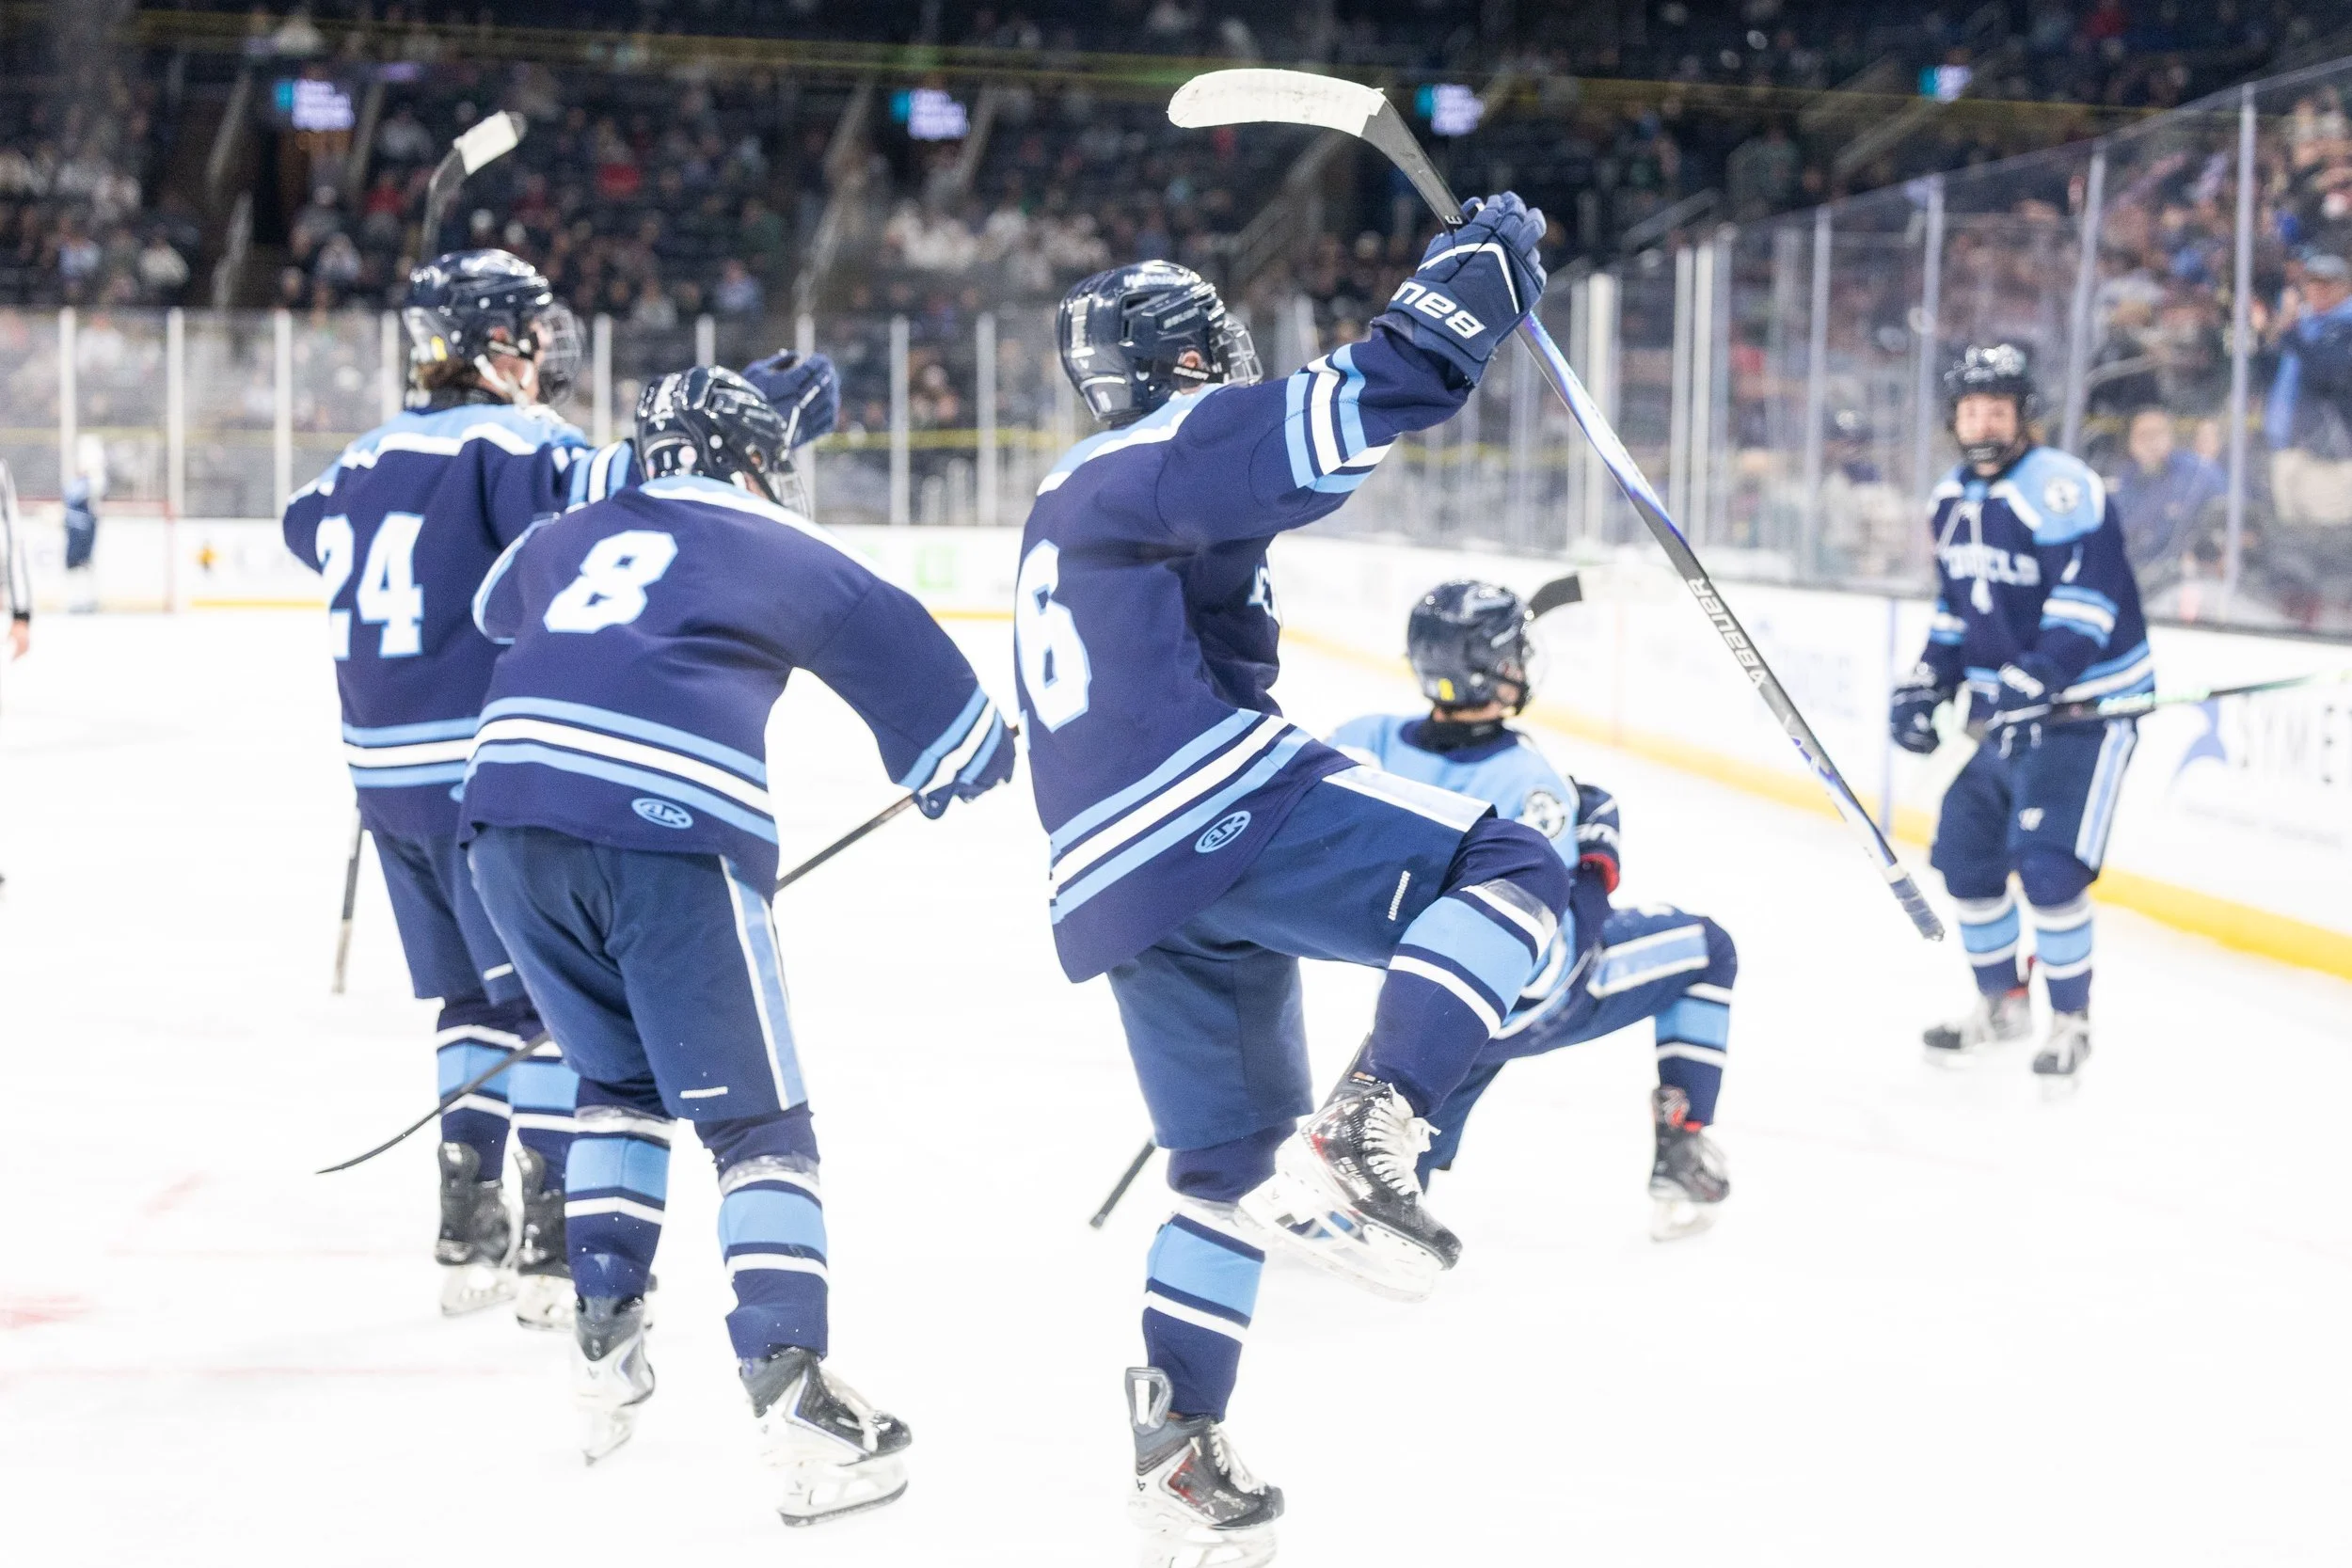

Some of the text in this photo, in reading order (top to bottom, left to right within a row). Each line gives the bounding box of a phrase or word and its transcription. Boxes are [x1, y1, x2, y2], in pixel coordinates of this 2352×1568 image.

[315, 511, 425, 660] 24
[543, 530, 679, 635] 8
[1687, 577, 1762, 669] BAUER
